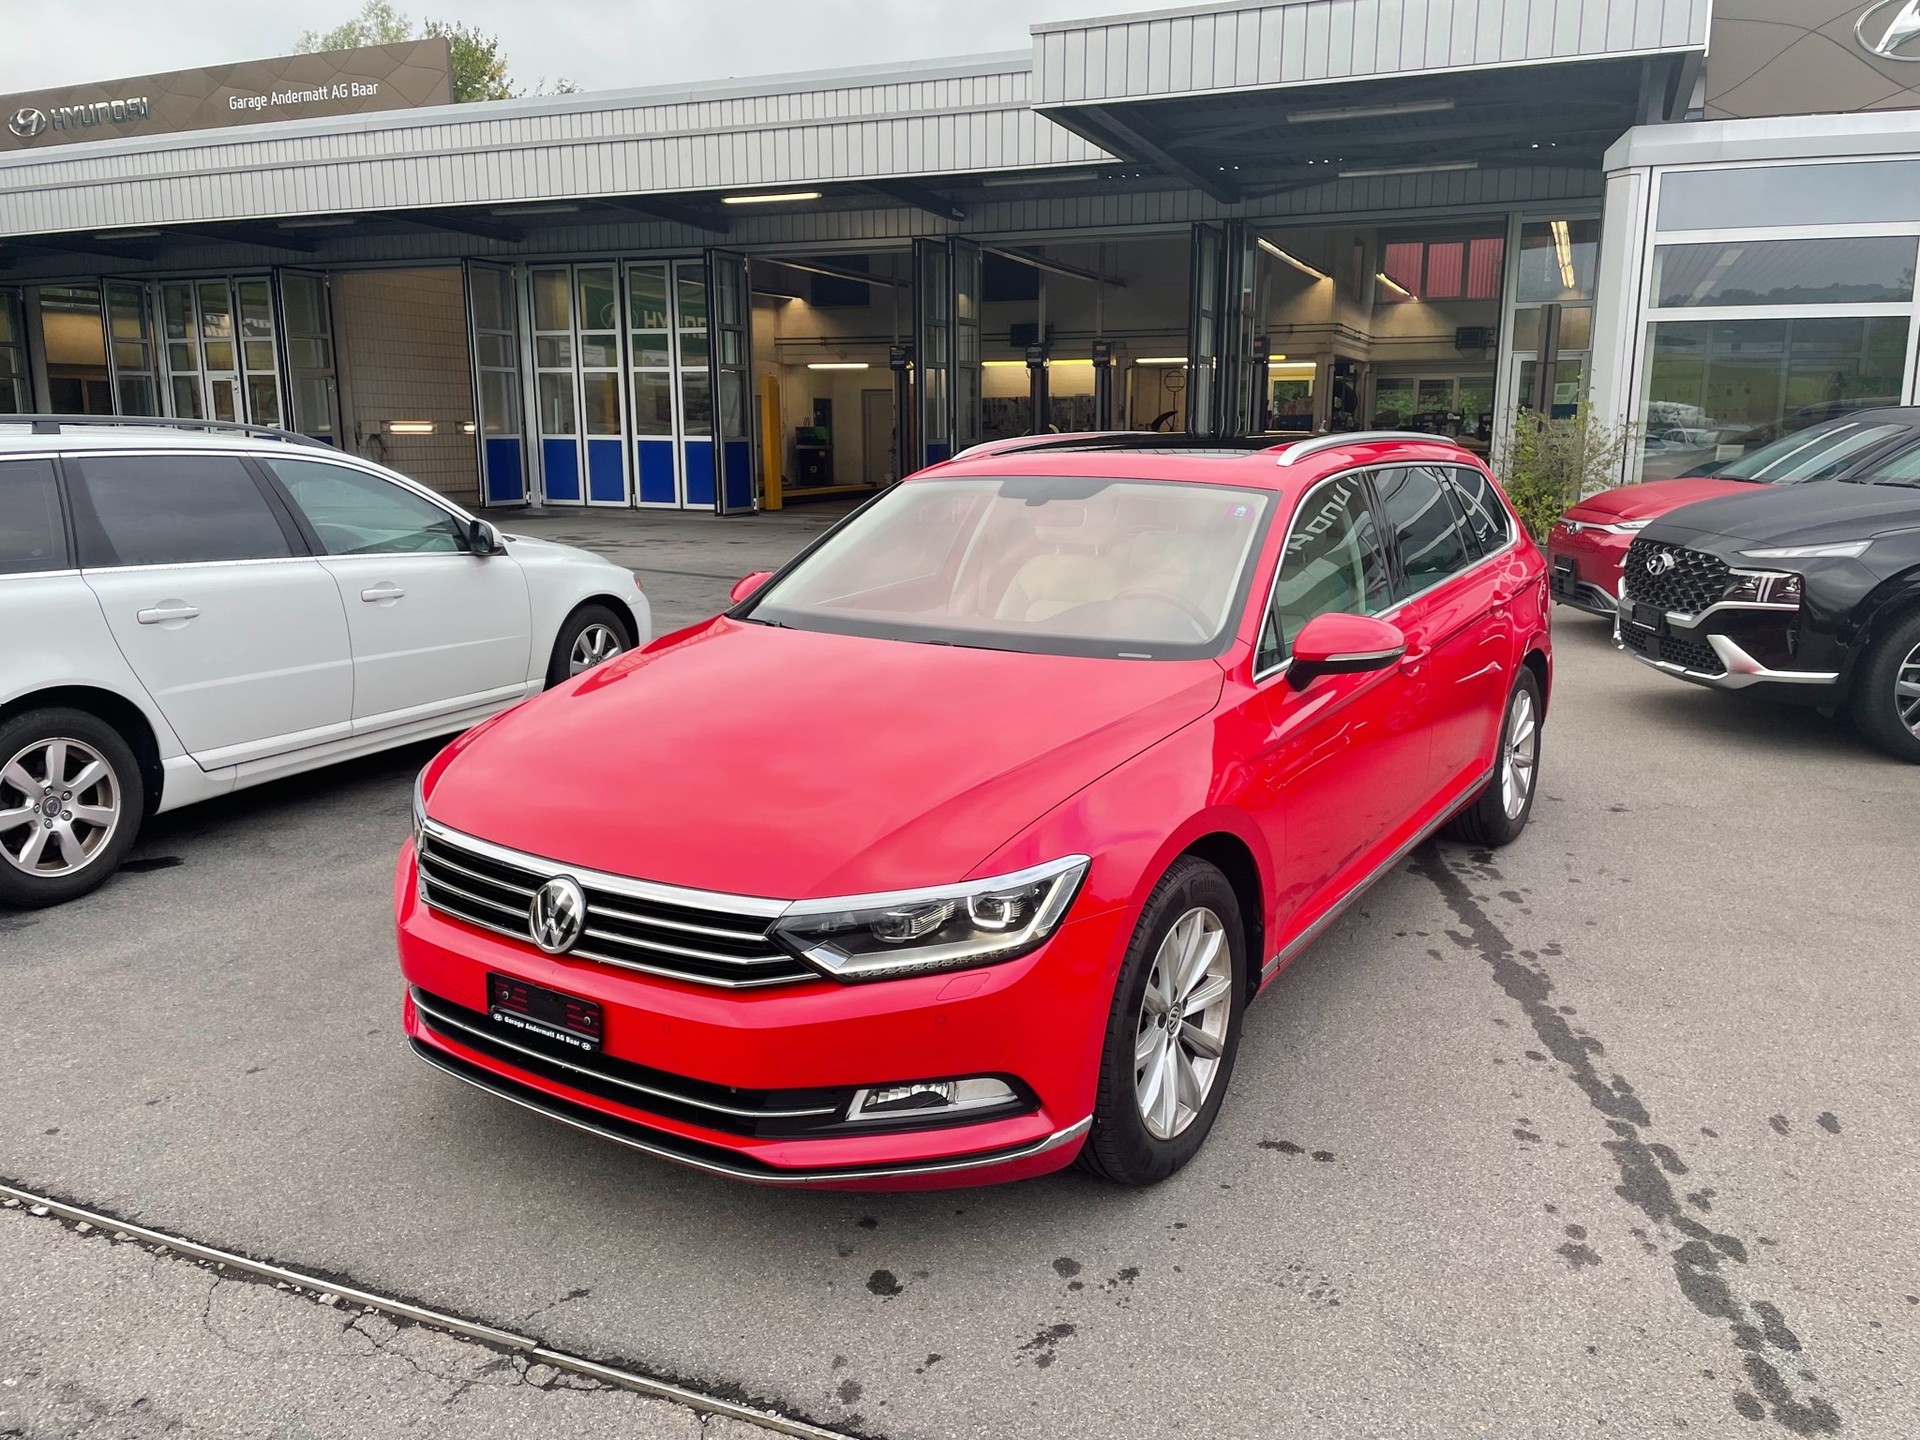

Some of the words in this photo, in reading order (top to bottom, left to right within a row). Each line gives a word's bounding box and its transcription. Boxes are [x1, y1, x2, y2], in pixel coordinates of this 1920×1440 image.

[228, 95, 268, 111] Garage
[271, 86, 328, 106] Andermatt
[331, 83, 348, 99] AG
[351, 82, 379, 97] Baar
[50, 97, 149, 131] HYUNDAI
[504, 1016, 524, 1028] Garage
[525, 1023, 555, 1038] Andermatt
[556, 1033, 565, 1041] AG
